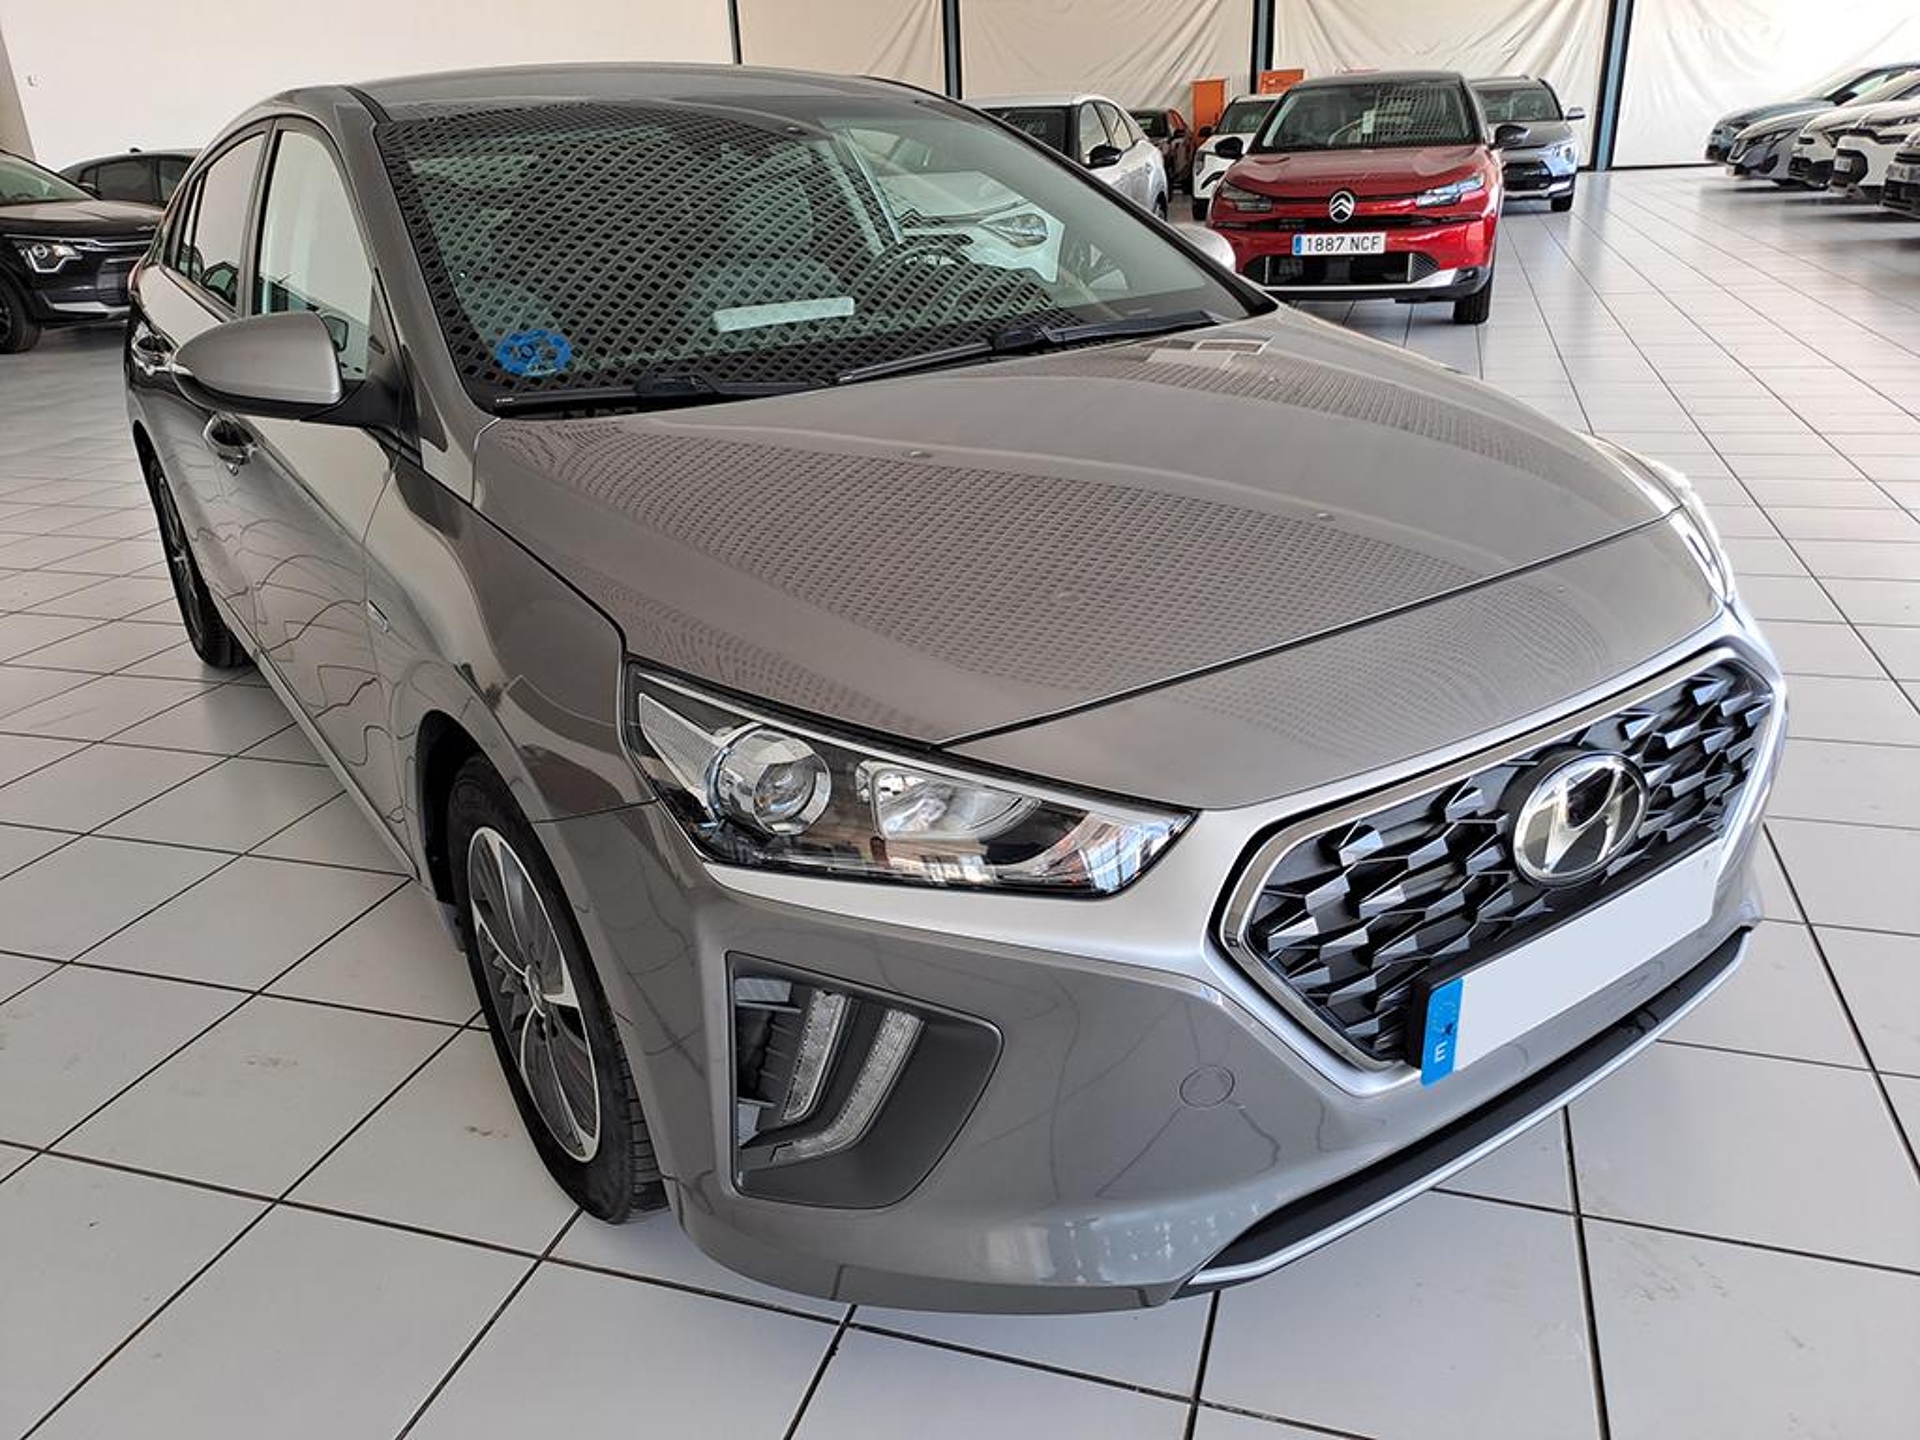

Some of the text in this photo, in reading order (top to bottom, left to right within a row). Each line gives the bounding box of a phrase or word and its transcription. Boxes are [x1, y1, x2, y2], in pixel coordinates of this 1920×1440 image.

[1306, 235, 1381, 252] 1887 NCF
[1433, 1040, 1448, 1064] E
